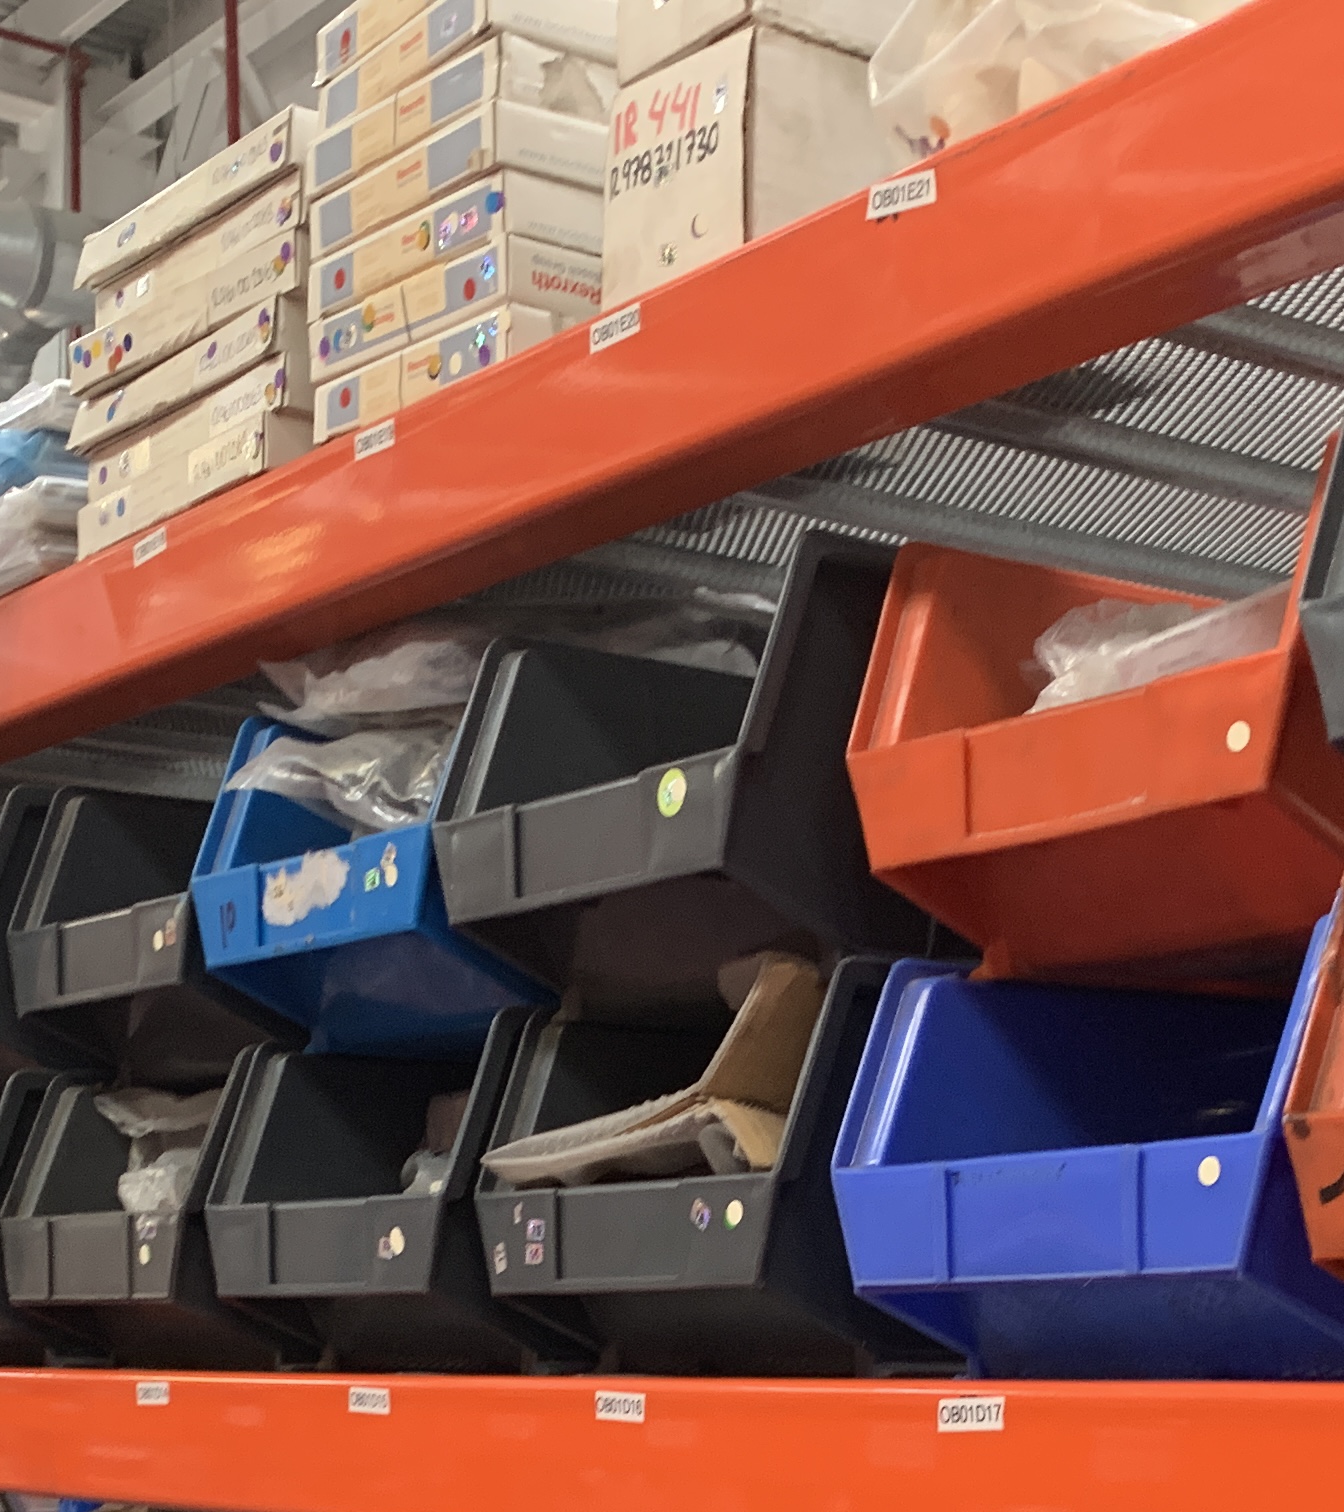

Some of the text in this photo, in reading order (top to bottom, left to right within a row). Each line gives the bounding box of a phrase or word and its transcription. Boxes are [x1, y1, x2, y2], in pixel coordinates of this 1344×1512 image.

[648, 82, 702, 136] 441
[872, 176, 933, 213] OB01E21
[592, 305, 641, 347] OB01E20
[939, 1403, 1003, 1425] OB01D17
